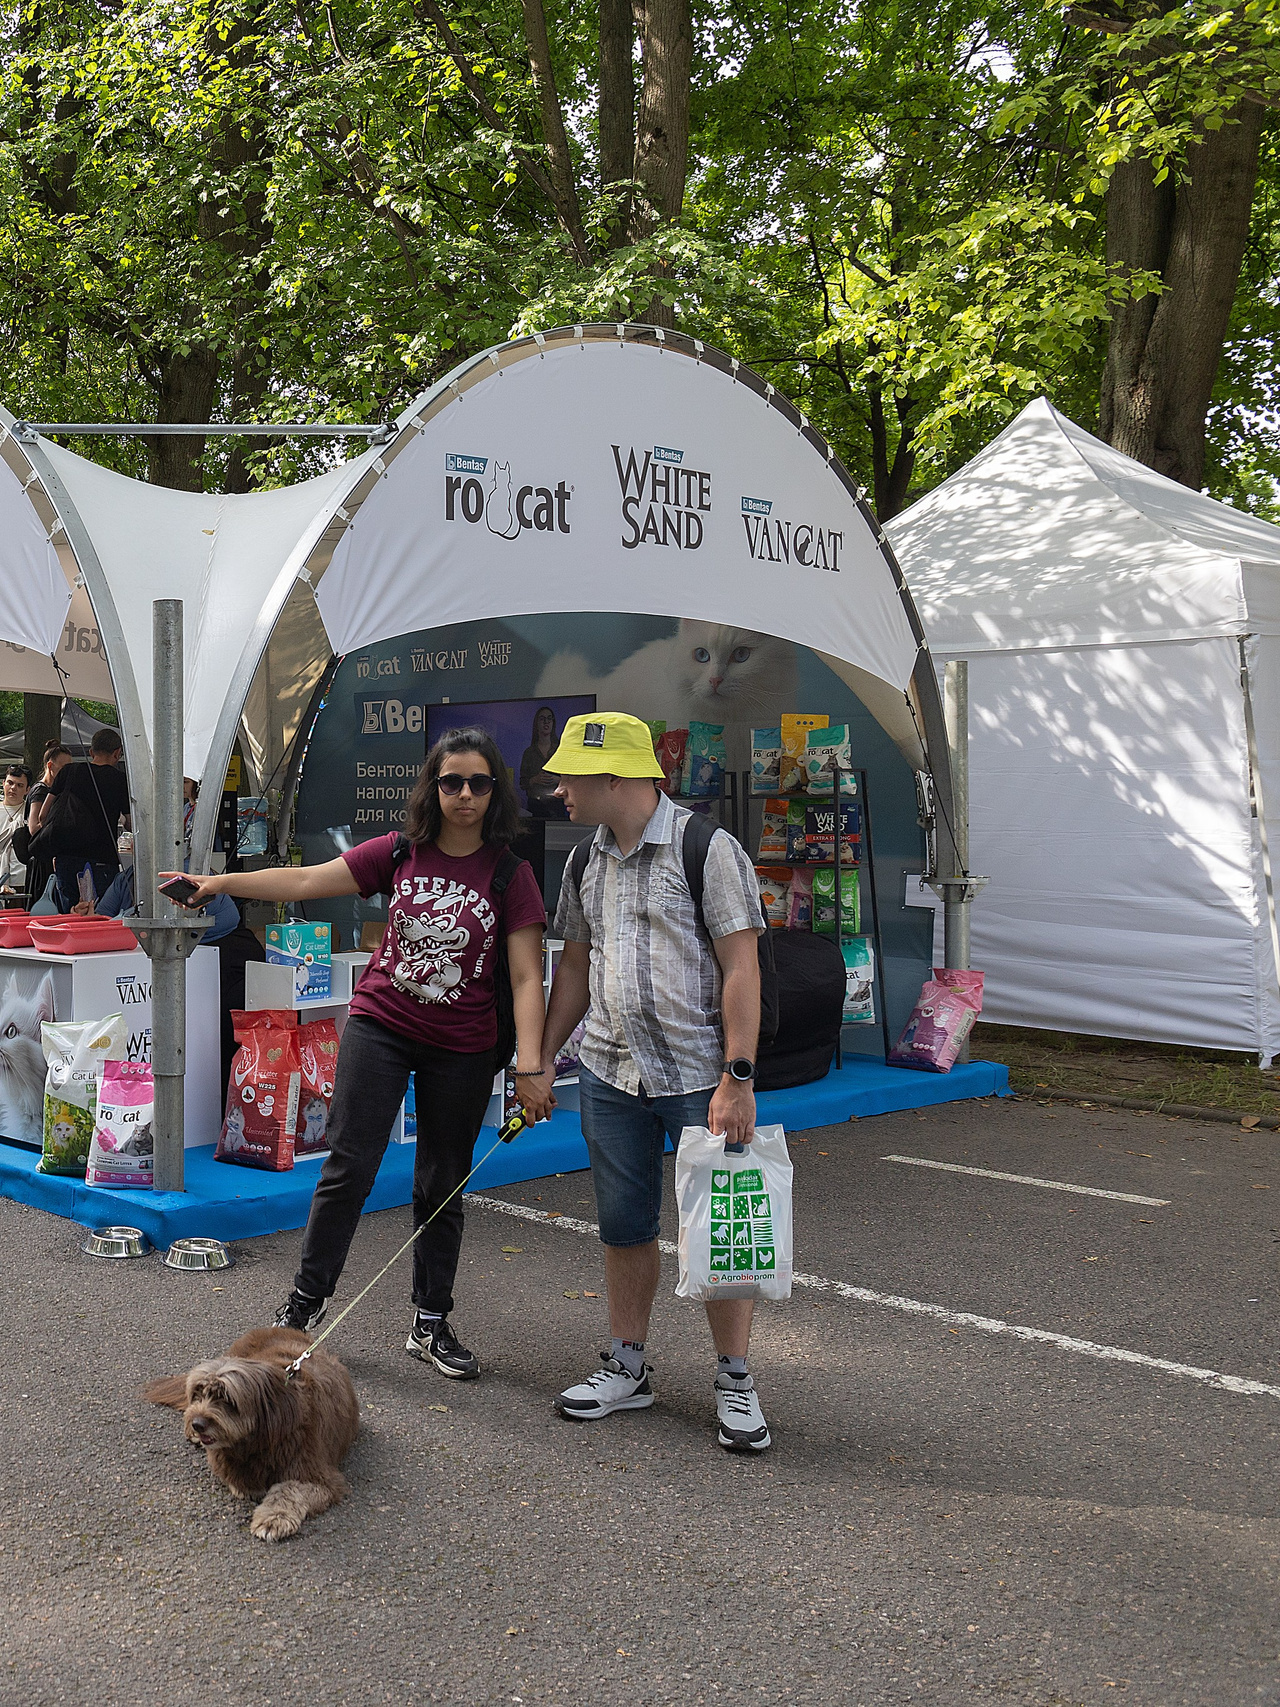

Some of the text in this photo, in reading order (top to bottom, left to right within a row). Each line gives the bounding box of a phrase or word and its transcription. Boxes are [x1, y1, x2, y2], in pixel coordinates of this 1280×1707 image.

[610, 444, 711, 511] WHITE
[621, 496, 703, 550] SAND
[478, 642, 512, 655] WHITE
[480, 654, 509, 668] SAND
[355, 809, 384, 824] для
[72, 1072, 86, 1080] Cat
[721, 1273, 775, 1282] Agrobioprom
